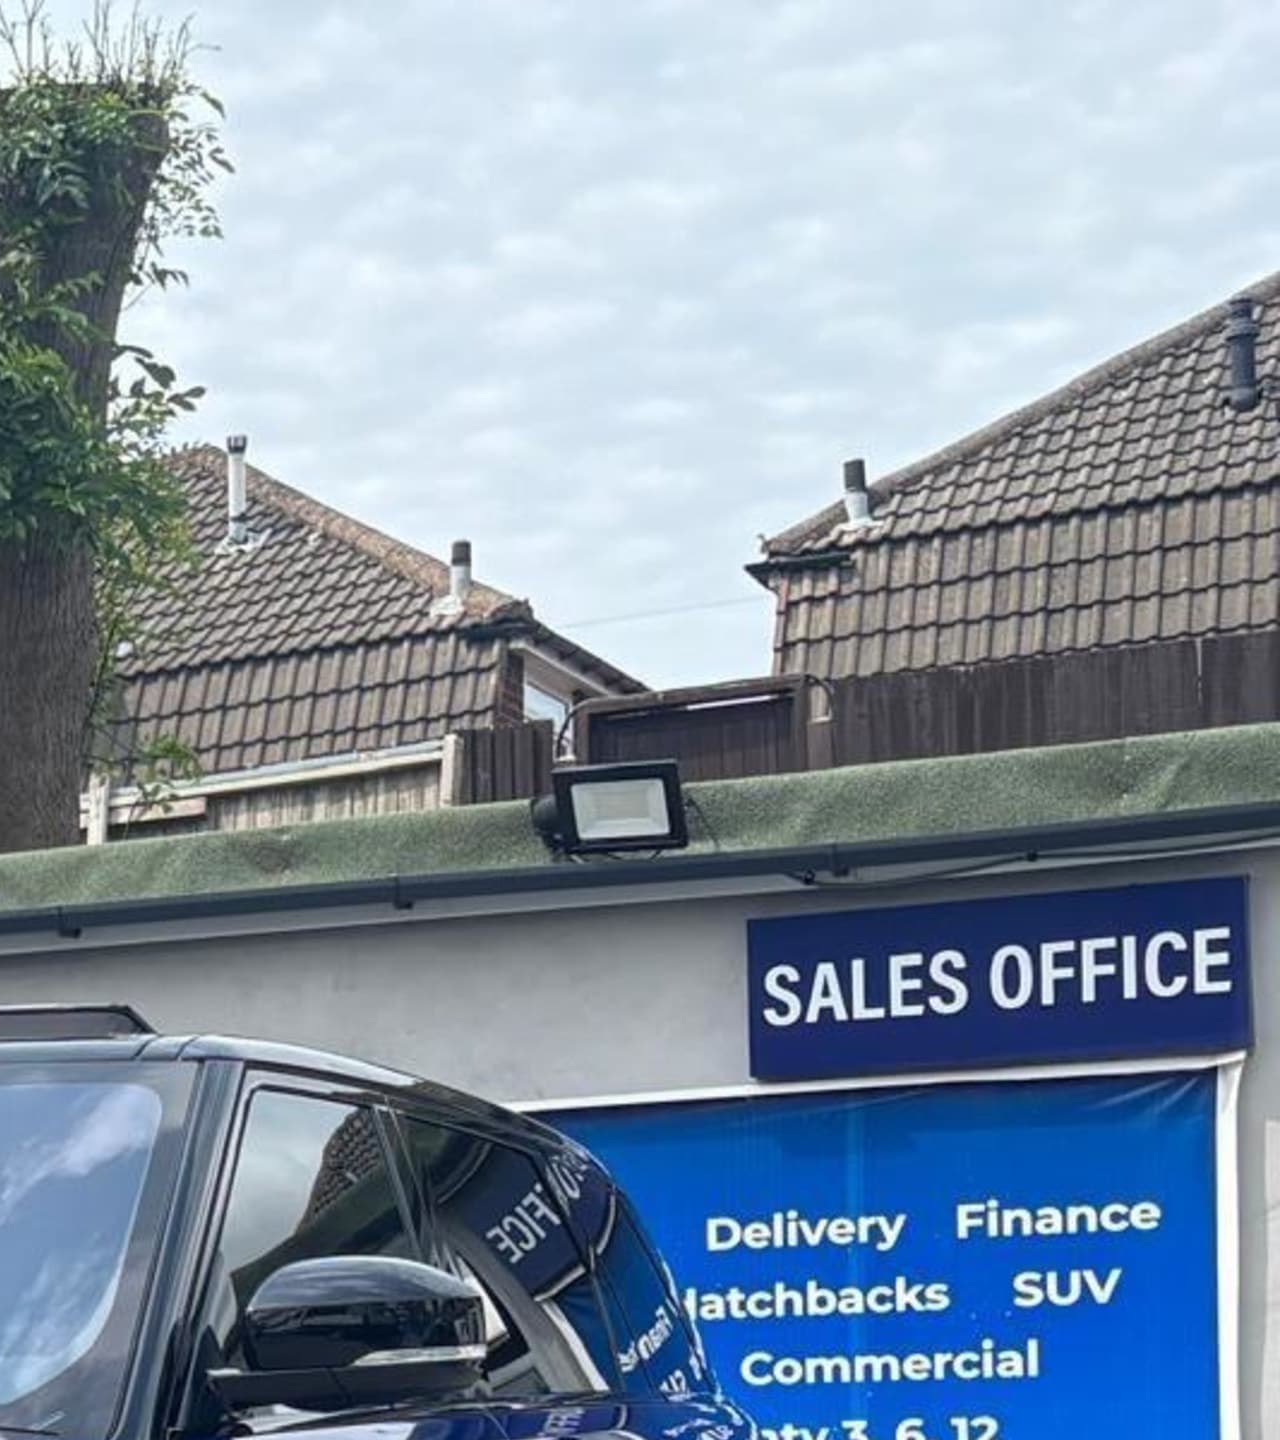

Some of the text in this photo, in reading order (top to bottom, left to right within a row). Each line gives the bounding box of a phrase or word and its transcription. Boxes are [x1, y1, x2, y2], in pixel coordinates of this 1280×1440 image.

[762, 926, 1233, 1027] SALES OFFICE
[705, 1199, 1162, 1252] Delivery Finance
[1012, 1268, 1122, 1308] SUV
[739, 1337, 1040, 1387] Commercial
